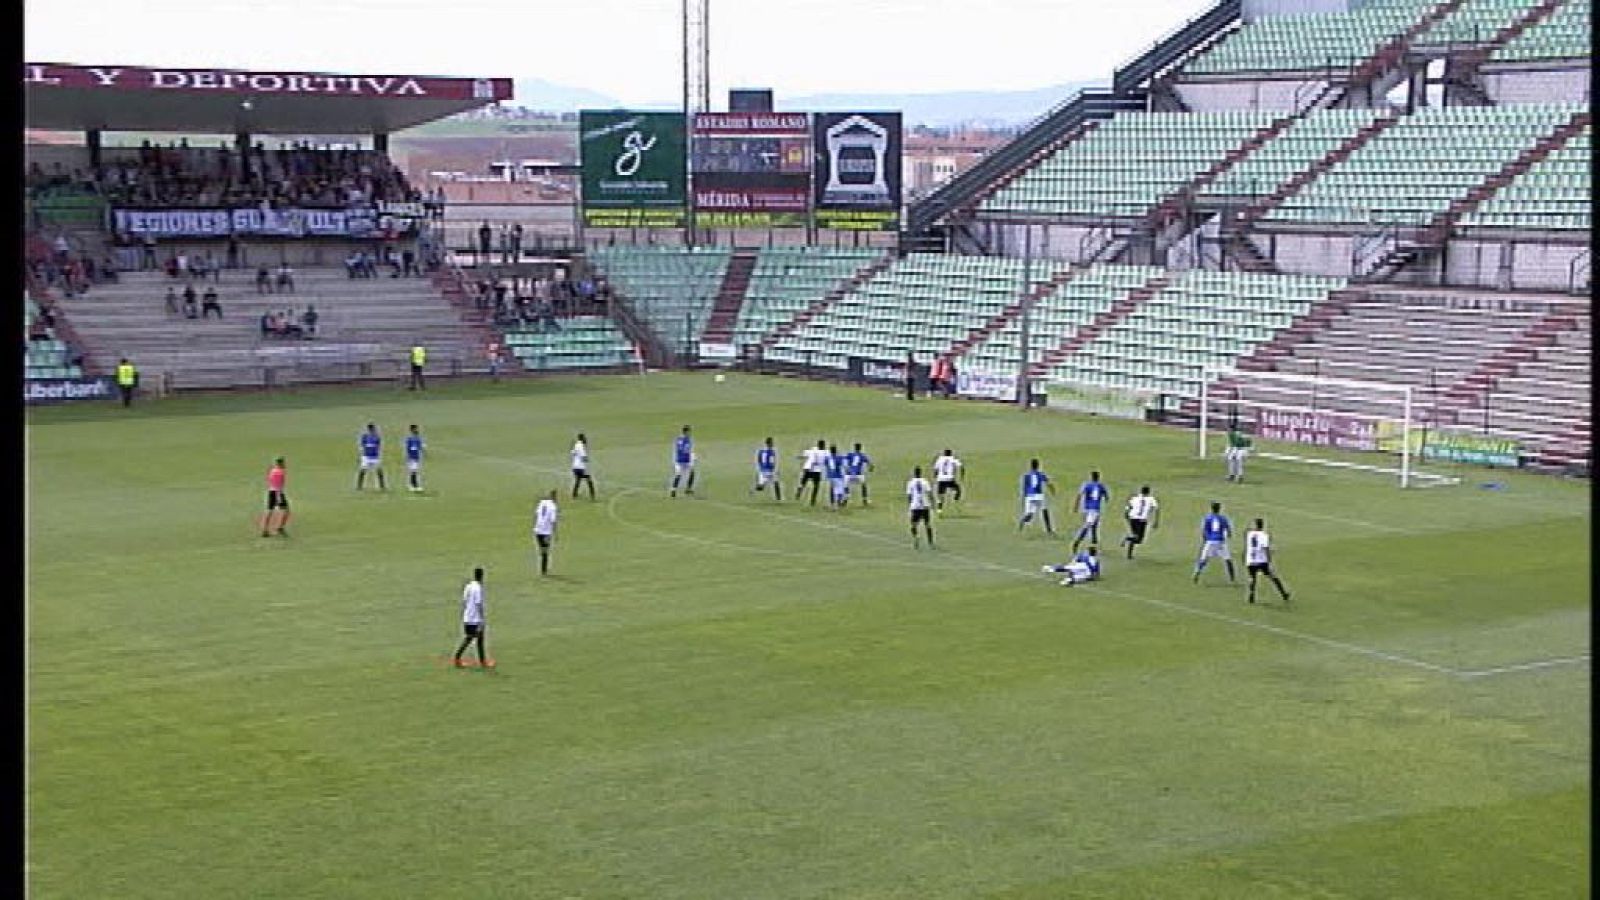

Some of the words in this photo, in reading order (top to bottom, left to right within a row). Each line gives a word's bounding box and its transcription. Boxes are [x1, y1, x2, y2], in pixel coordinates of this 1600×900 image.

[92, 68, 122, 86] Y
[151, 71, 425, 95] DEPORTIVA
[752, 115, 806, 129] ROMANO
